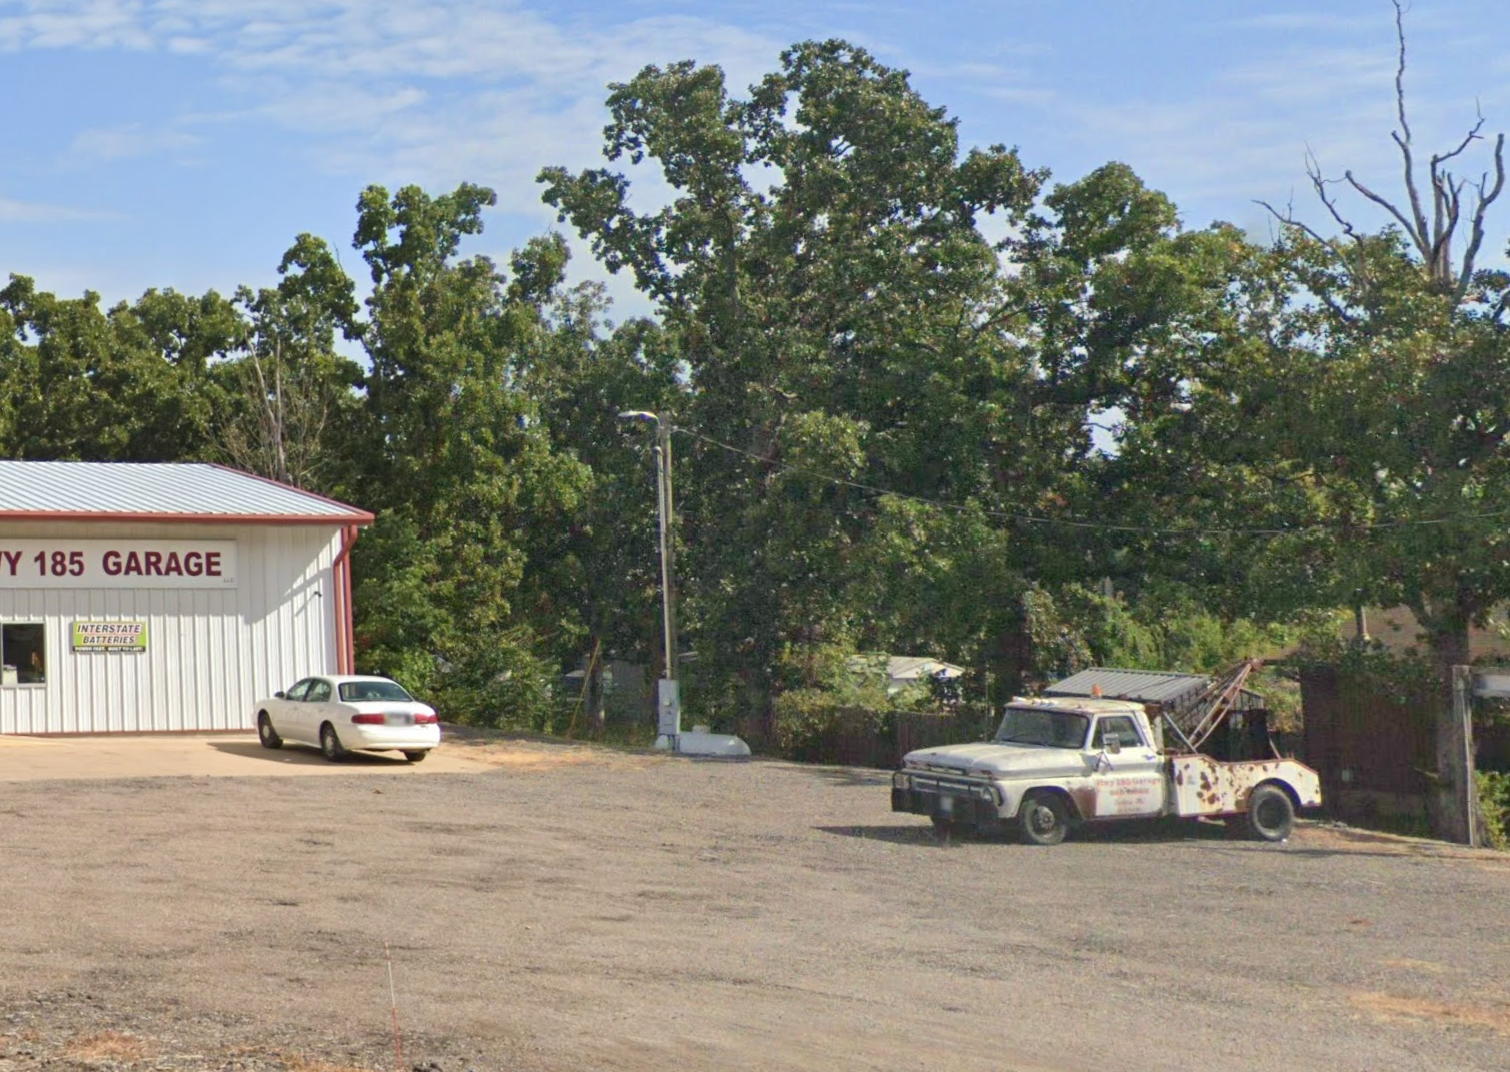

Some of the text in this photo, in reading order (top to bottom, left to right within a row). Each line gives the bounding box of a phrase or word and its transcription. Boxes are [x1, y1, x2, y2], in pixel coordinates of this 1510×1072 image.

[33, 551, 85, 577] 185
[101, 550, 222, 577] GARAGE
[77, 624, 141, 633] INTERSTATE
[83, 635, 135, 644] BATTERIES
